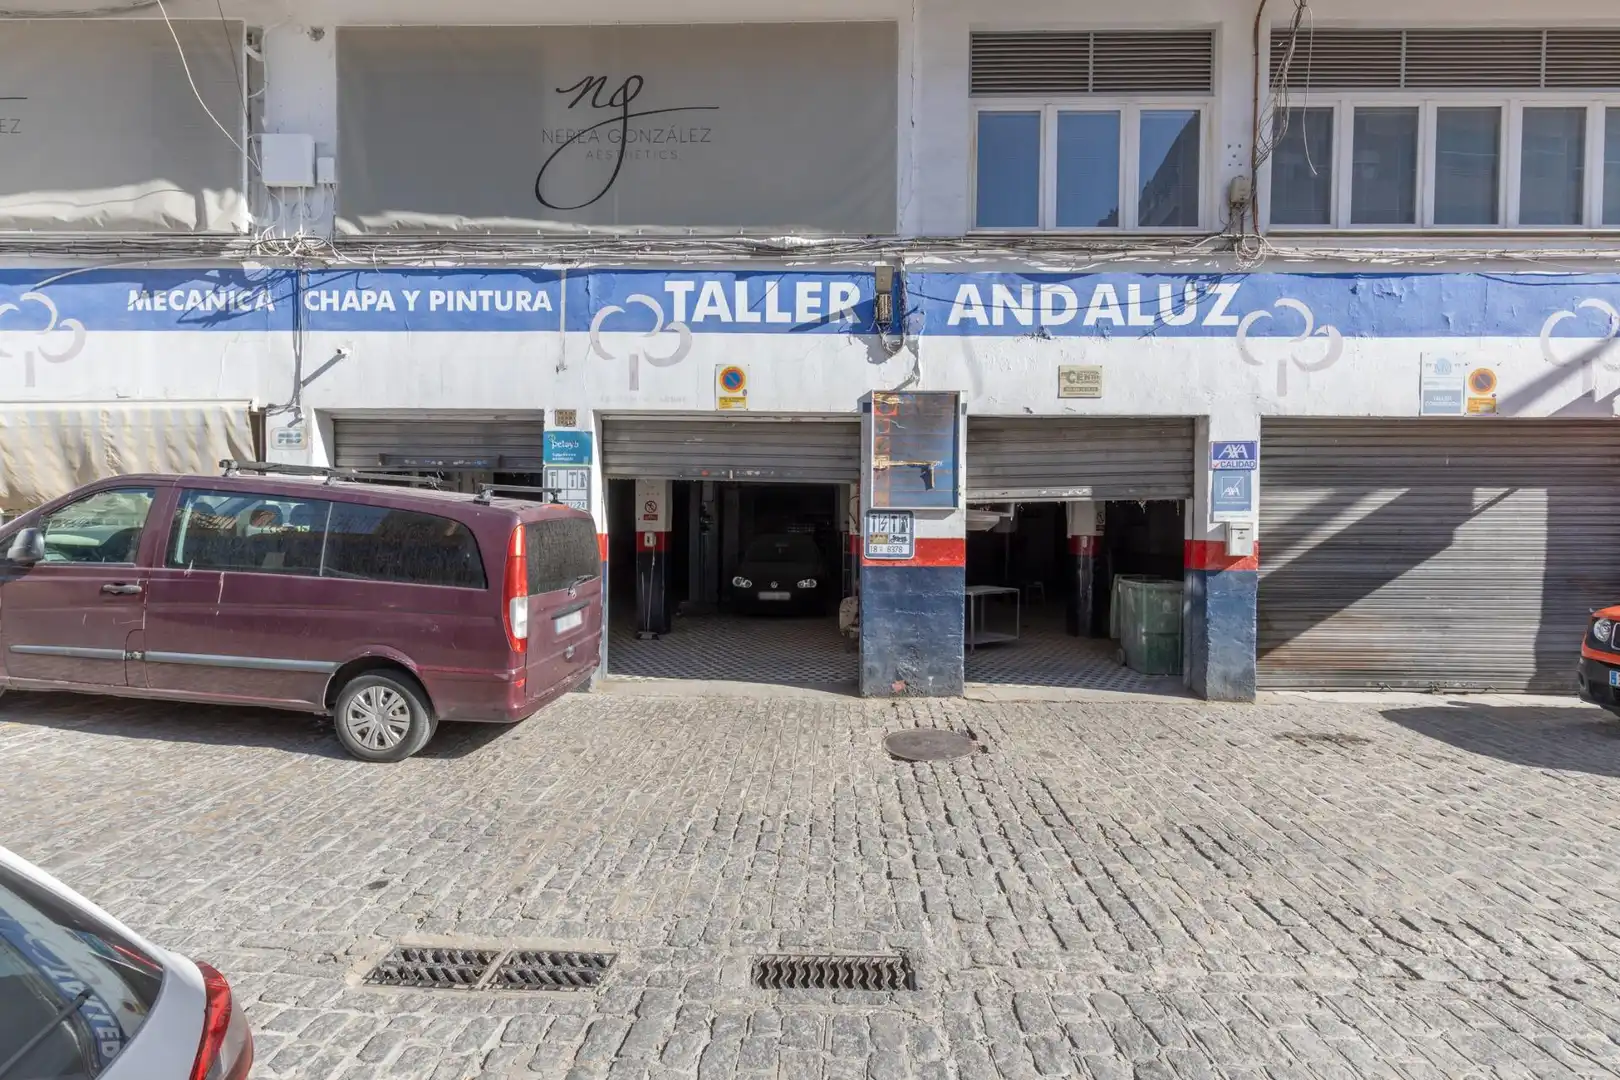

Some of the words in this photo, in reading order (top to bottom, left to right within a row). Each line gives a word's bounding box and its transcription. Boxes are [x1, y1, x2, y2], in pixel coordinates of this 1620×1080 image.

[542, 128, 600, 144] NEREA
[608, 125, 712, 144] GONZÁLEZ
[586, 150, 678, 160] AESTHETICS
[127, 290, 276, 312] MECANICA
[304, 290, 396, 312] CHAPA
[402, 290, 421, 312] Y
[429, 290, 553, 312] PINTURA
[664, 280, 861, 323] TALLER
[947, 283, 1240, 326] ANDALUZ
[1218, 444, 1249, 459] AXA
